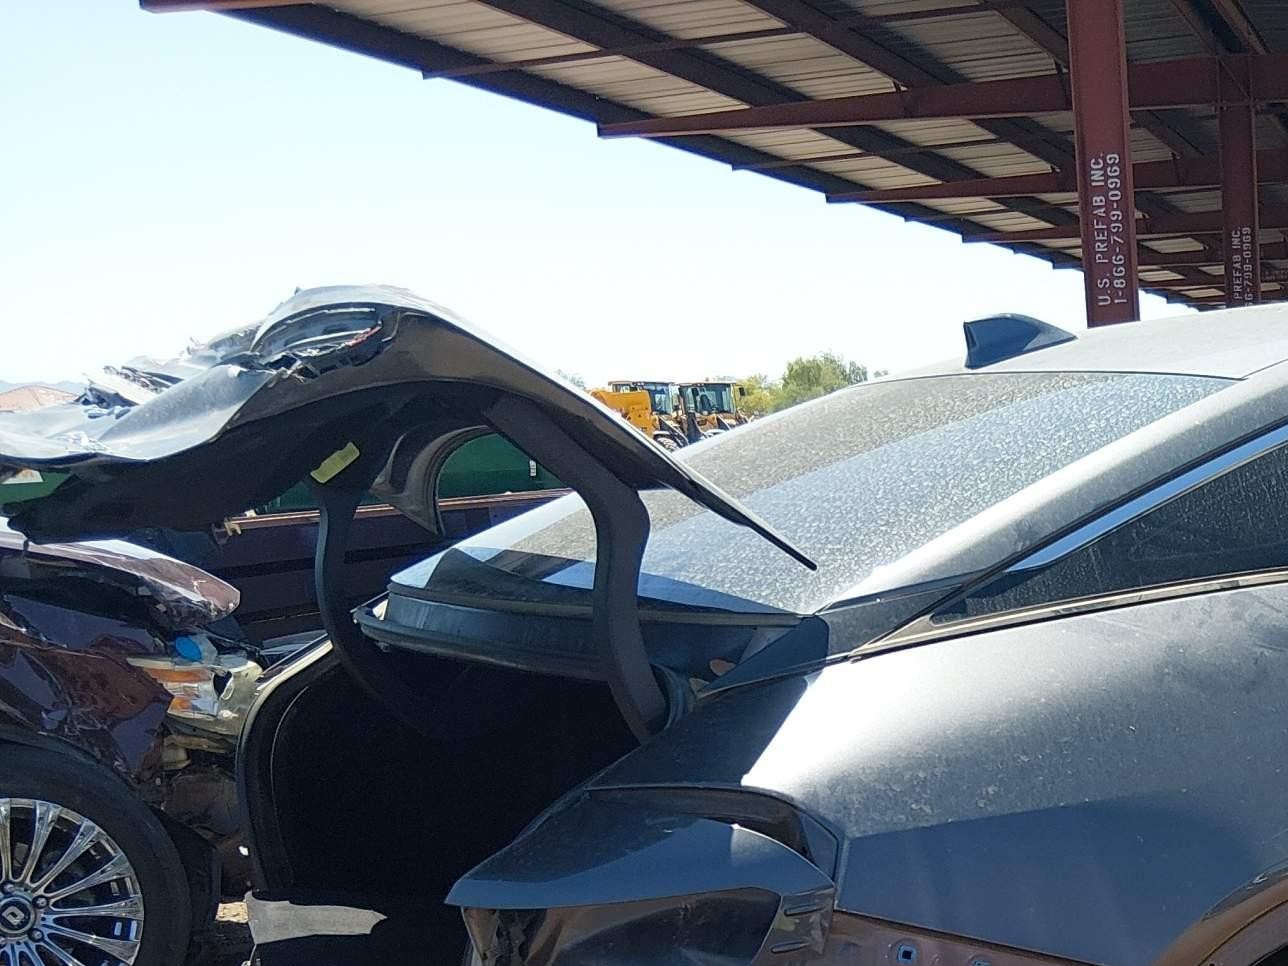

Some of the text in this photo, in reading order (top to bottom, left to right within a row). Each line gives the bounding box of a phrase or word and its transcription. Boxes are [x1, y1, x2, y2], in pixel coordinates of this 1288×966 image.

[1090, 152, 1112, 306] U.S. PREFAB INC.
[1106, 153, 1128, 304] 1-866-799-0969
[1231, 254, 1243, 300] PREFAB
